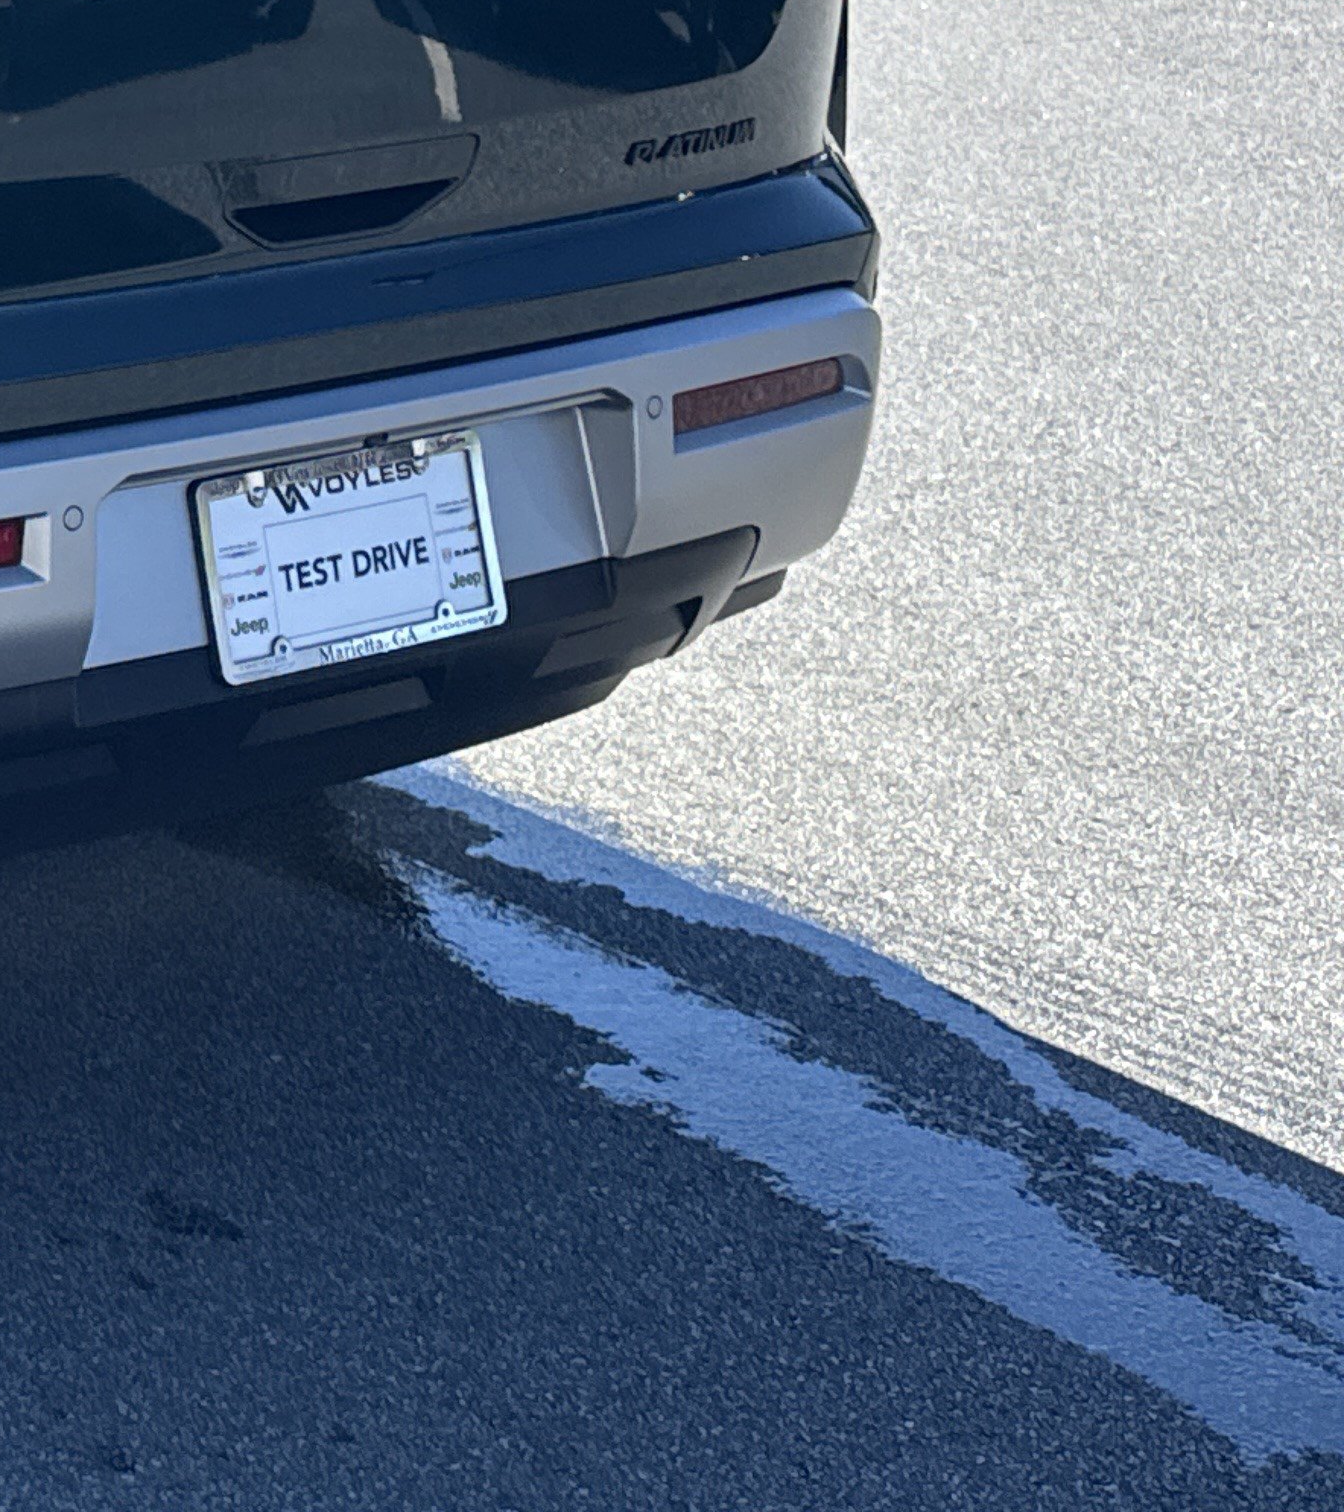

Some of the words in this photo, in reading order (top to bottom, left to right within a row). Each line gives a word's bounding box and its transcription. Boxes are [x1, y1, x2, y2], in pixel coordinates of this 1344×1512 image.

[623, 116, 757, 167] PLATINUM
[310, 460, 411, 497] VOYLES
[278, 553, 342, 592] TEST
[351, 536, 429, 578] DRIVE
[449, 571, 481, 590] Jeep
[230, 617, 269, 636] Jeep
